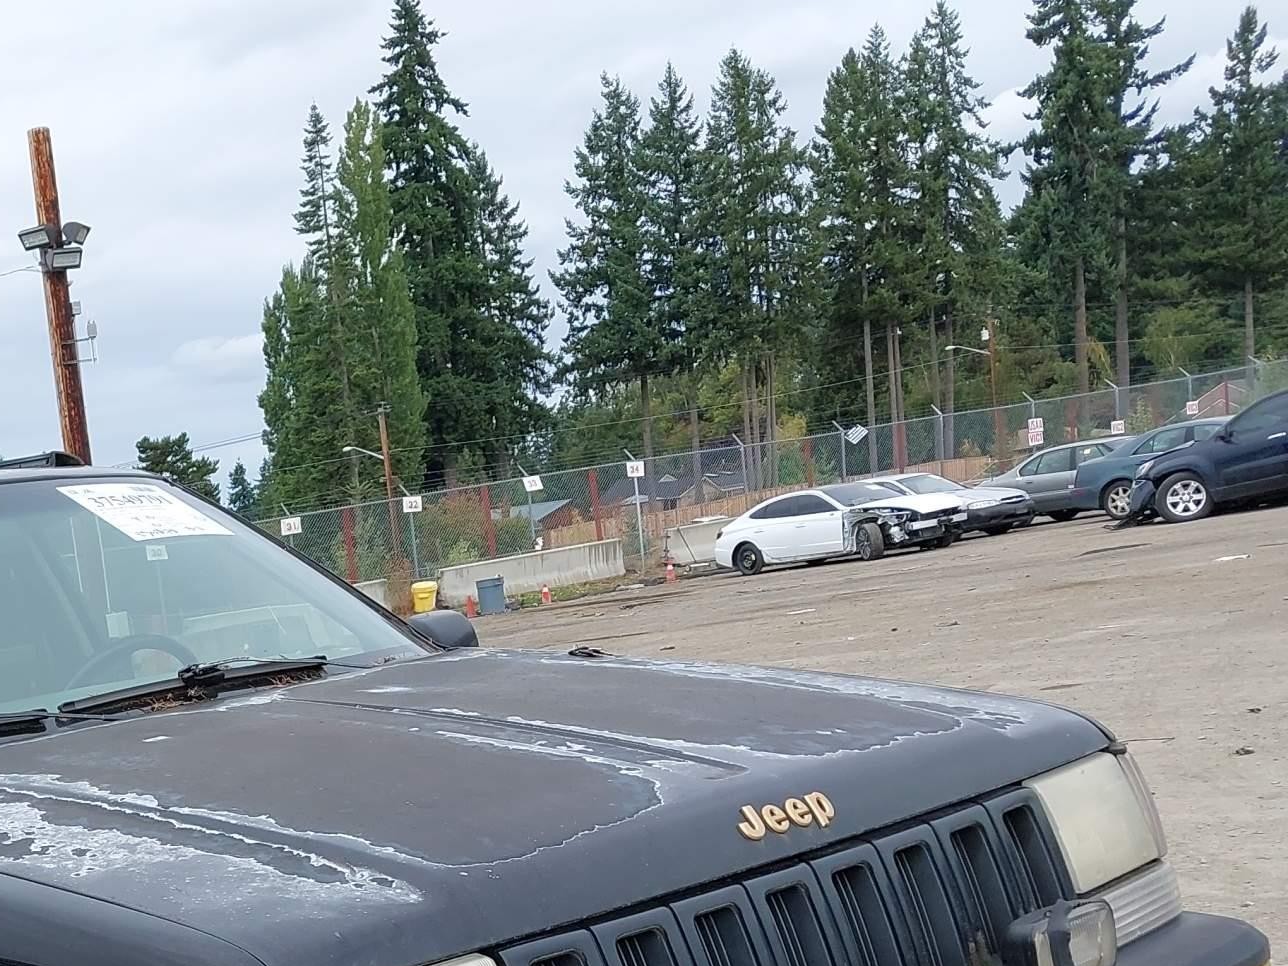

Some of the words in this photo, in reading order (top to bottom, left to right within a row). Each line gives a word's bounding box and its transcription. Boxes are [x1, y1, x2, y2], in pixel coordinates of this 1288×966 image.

[630, 464, 640, 474] 34
[527, 479, 538, 488] 33
[88, 494, 174, 508] 37549791
[408, 499, 419, 509] 32
[286, 521, 297, 532] 31
[737, 791, 835, 840] Jeep
